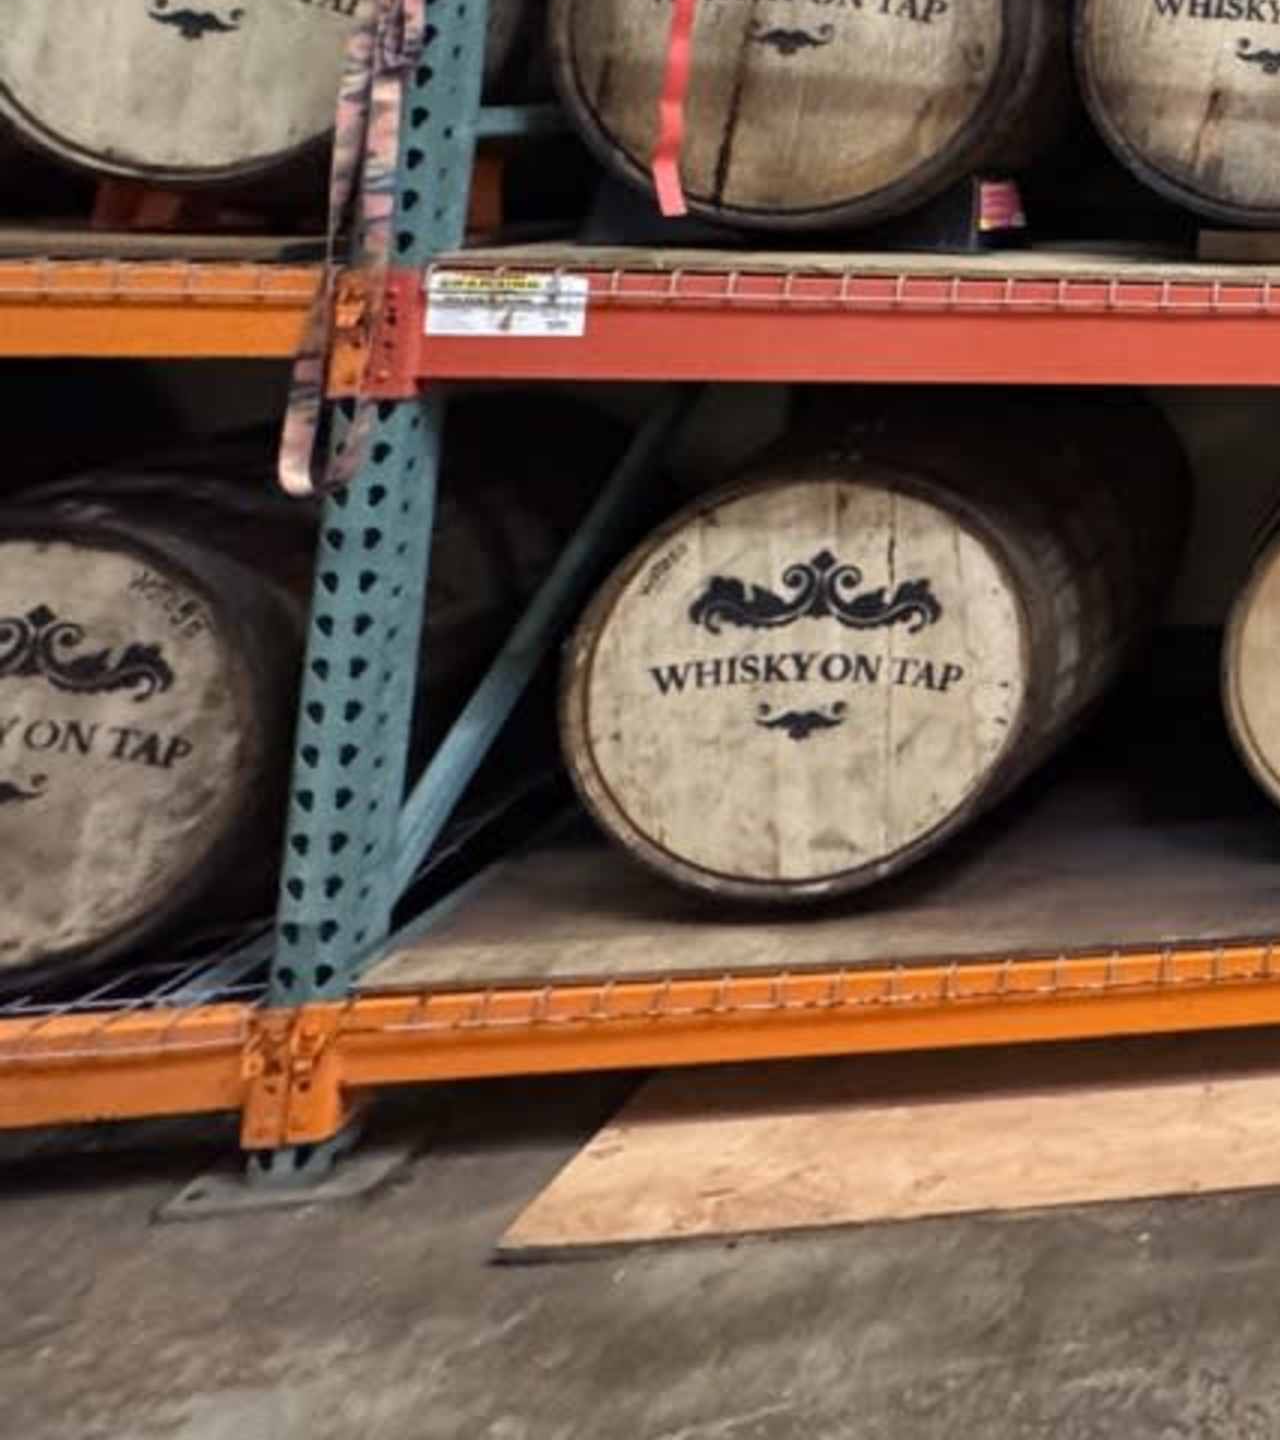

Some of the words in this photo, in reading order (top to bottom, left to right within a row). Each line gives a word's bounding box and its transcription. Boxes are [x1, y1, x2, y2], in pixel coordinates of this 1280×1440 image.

[650, 652, 821, 695] WHISKY
[820, 652, 882, 683] ON
[888, 658, 963, 692] TAP
[23, 719, 99, 755] ON
[109, 724, 193, 769] TAP
